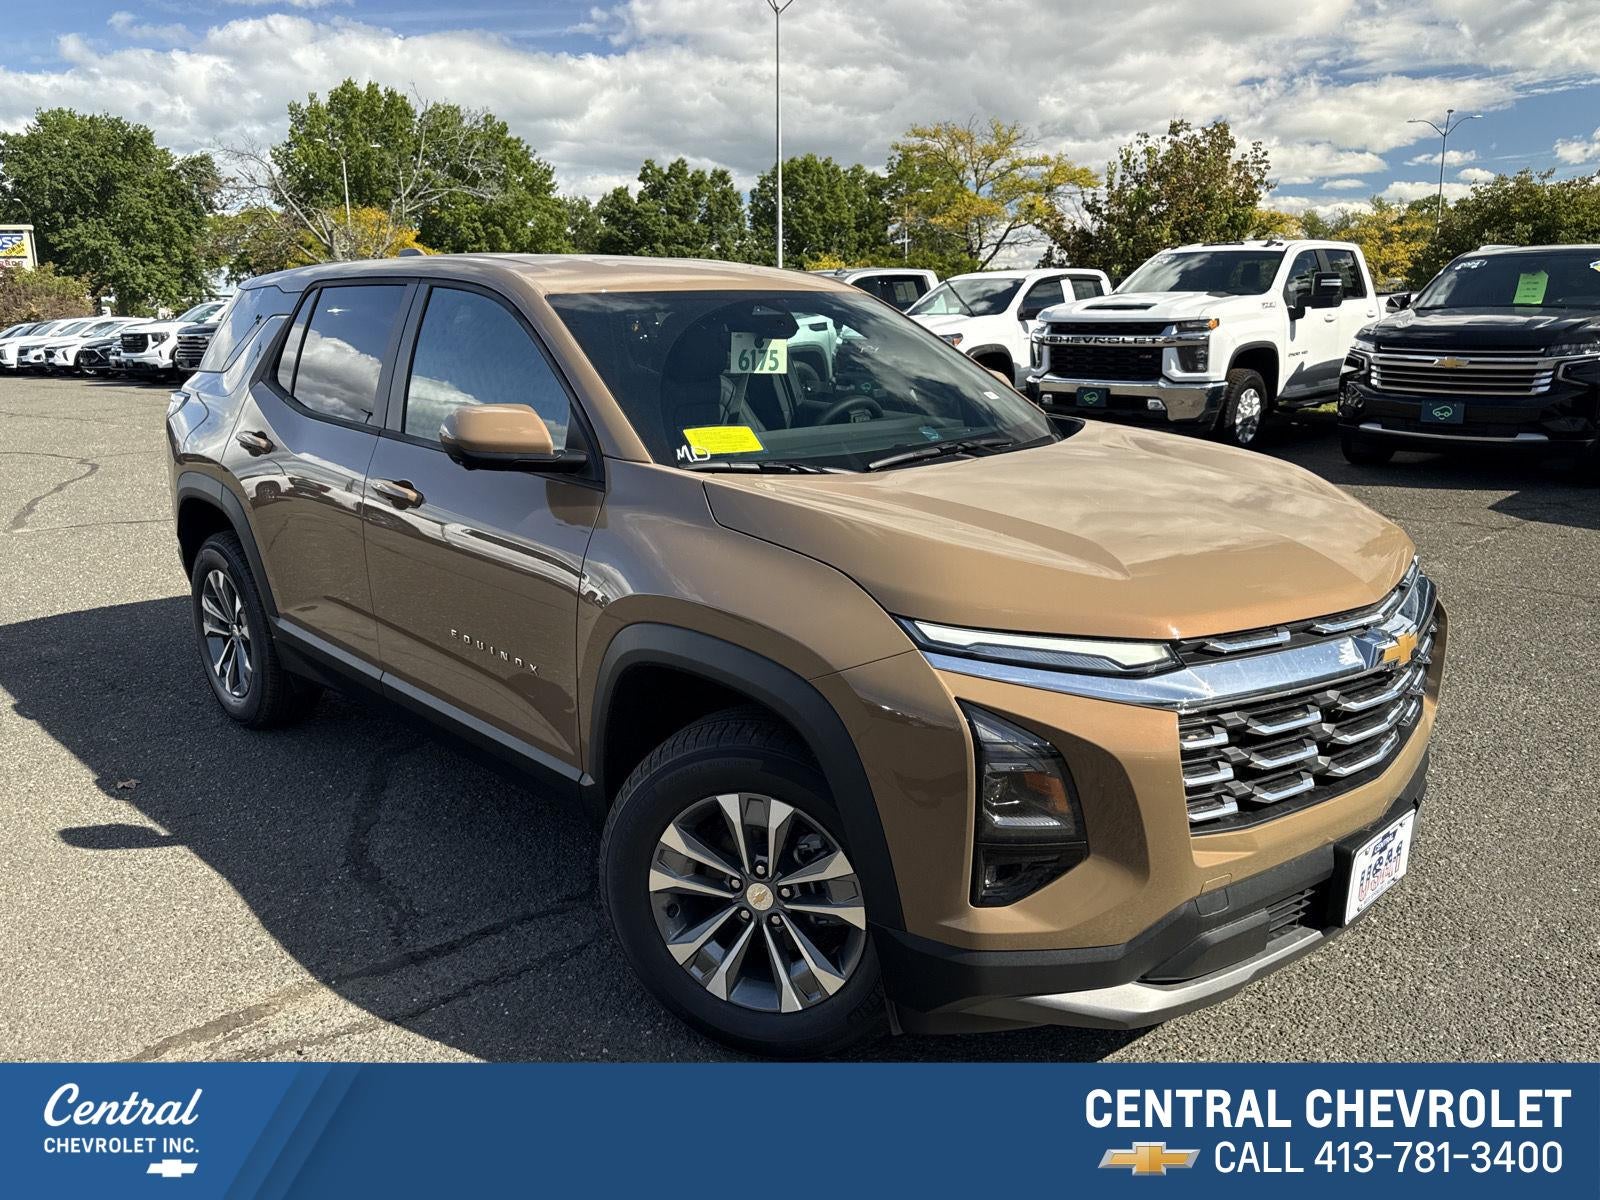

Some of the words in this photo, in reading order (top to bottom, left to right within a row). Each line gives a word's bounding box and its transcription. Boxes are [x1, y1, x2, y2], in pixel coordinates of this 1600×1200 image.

[1048, 336, 1161, 345] CHEVROLET
[738, 349, 779, 371] 6175
[450, 629, 540, 676] EQUINOX
